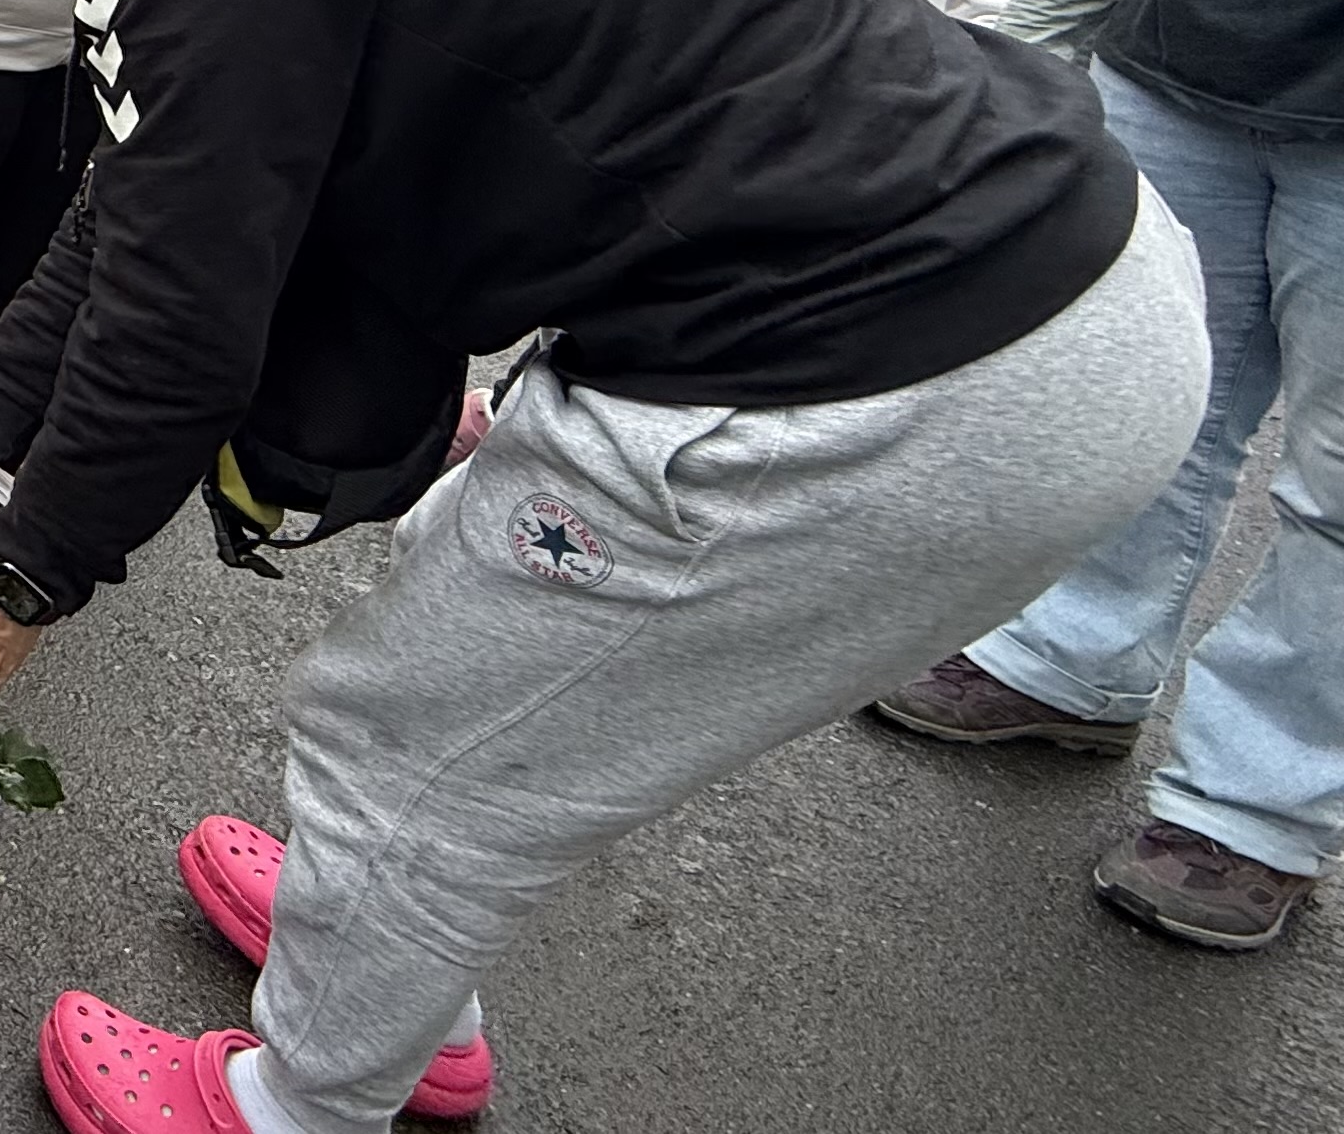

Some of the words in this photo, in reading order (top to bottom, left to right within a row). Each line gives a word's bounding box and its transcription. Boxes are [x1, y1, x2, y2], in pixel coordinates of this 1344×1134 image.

[532, 502, 602, 559] CONVERSE
[515, 533, 530, 559] ALL
[531, 560, 575, 583] STAR
